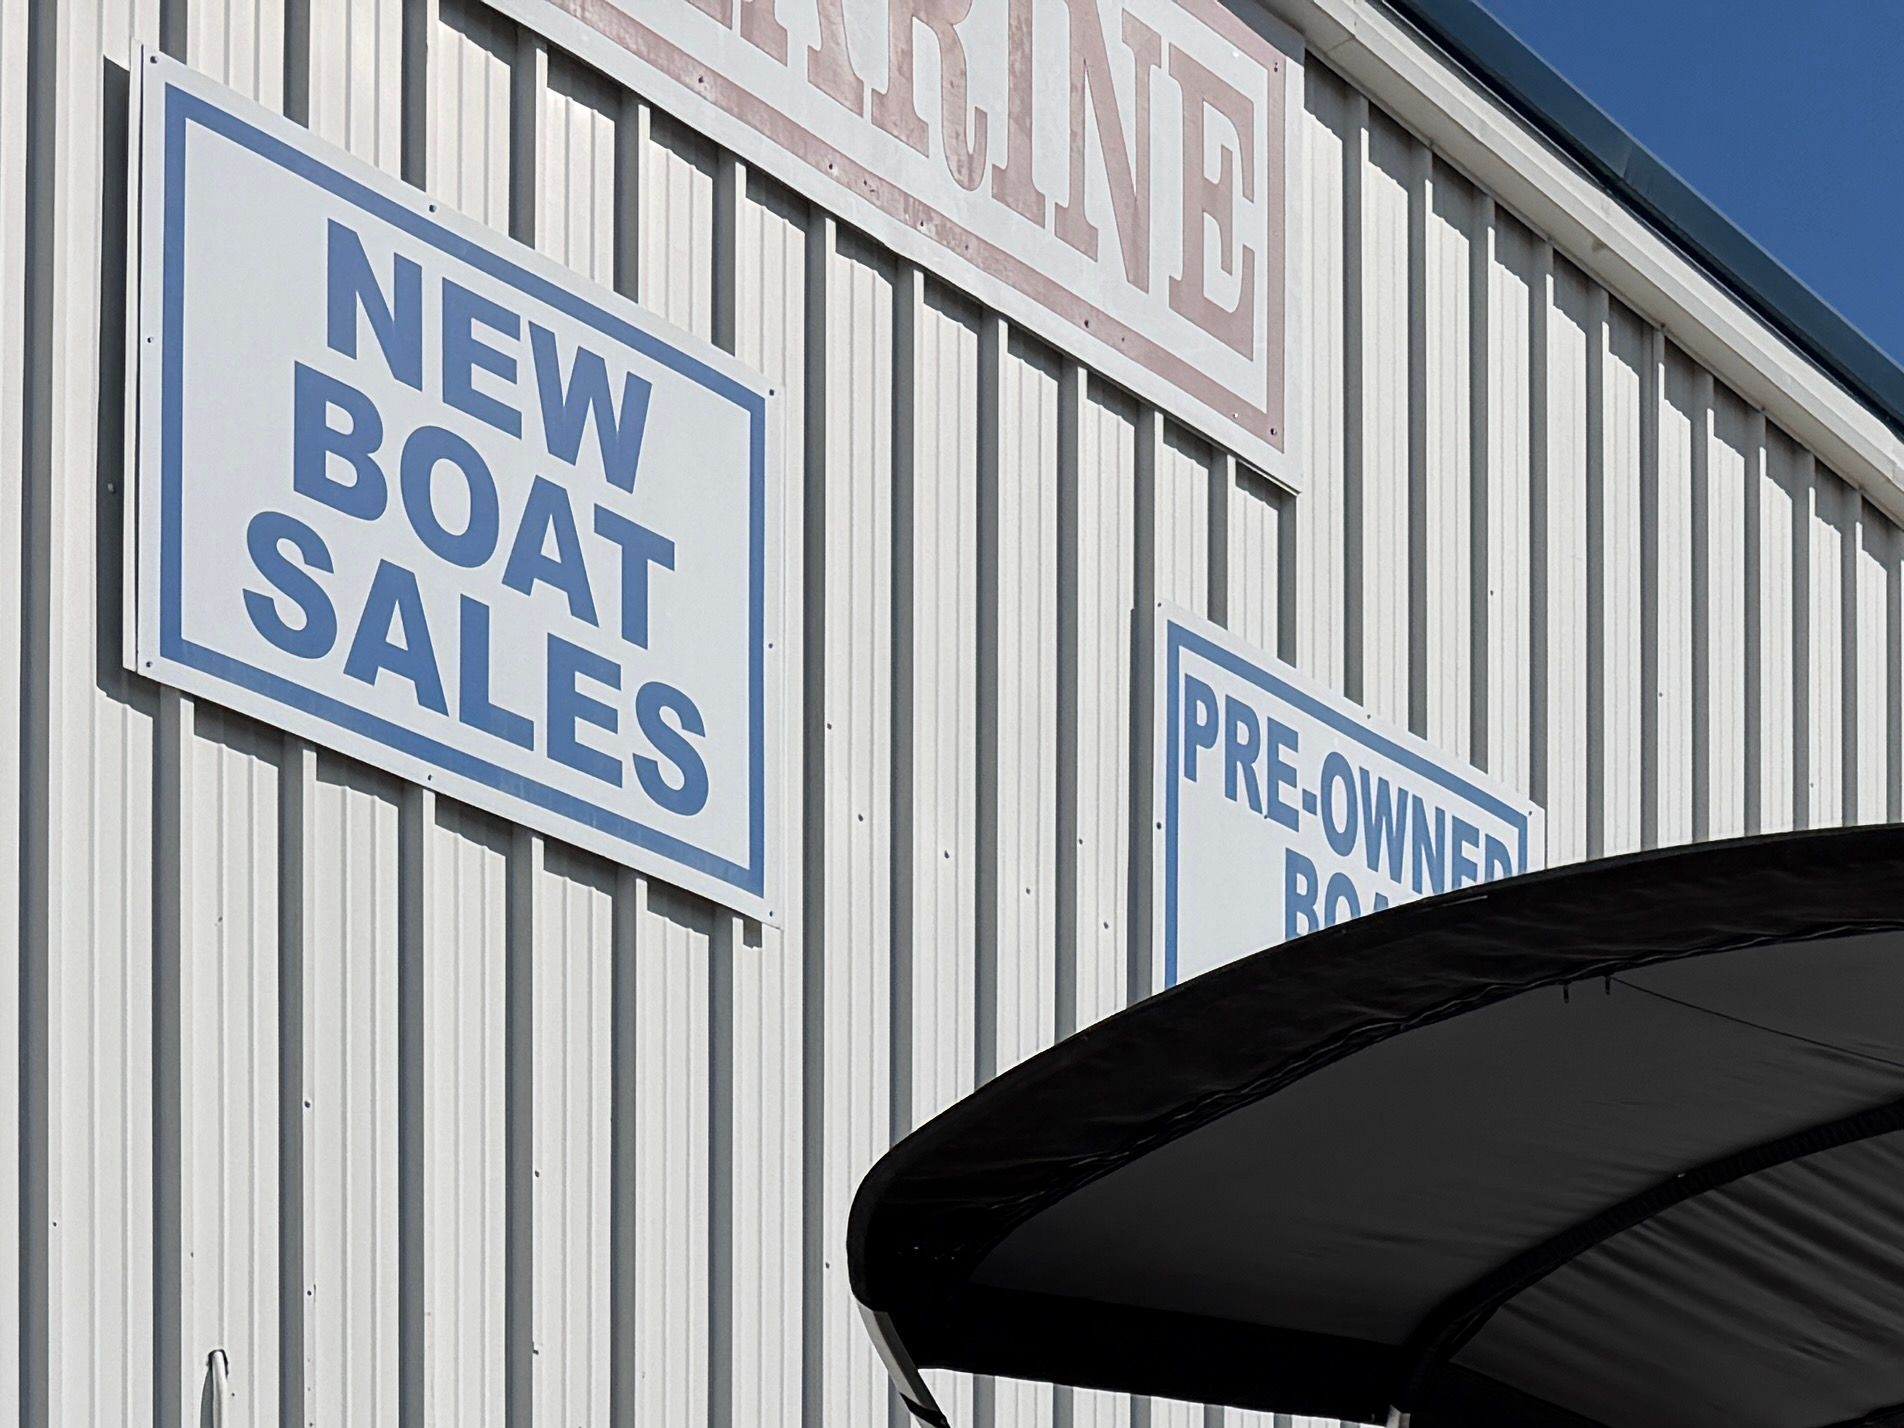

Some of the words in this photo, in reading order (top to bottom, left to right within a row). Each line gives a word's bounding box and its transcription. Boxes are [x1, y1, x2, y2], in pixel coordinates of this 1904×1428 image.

[327, 217, 652, 495] NEW
[294, 360, 675, 651] BOAT
[243, 510, 709, 817] SALES
